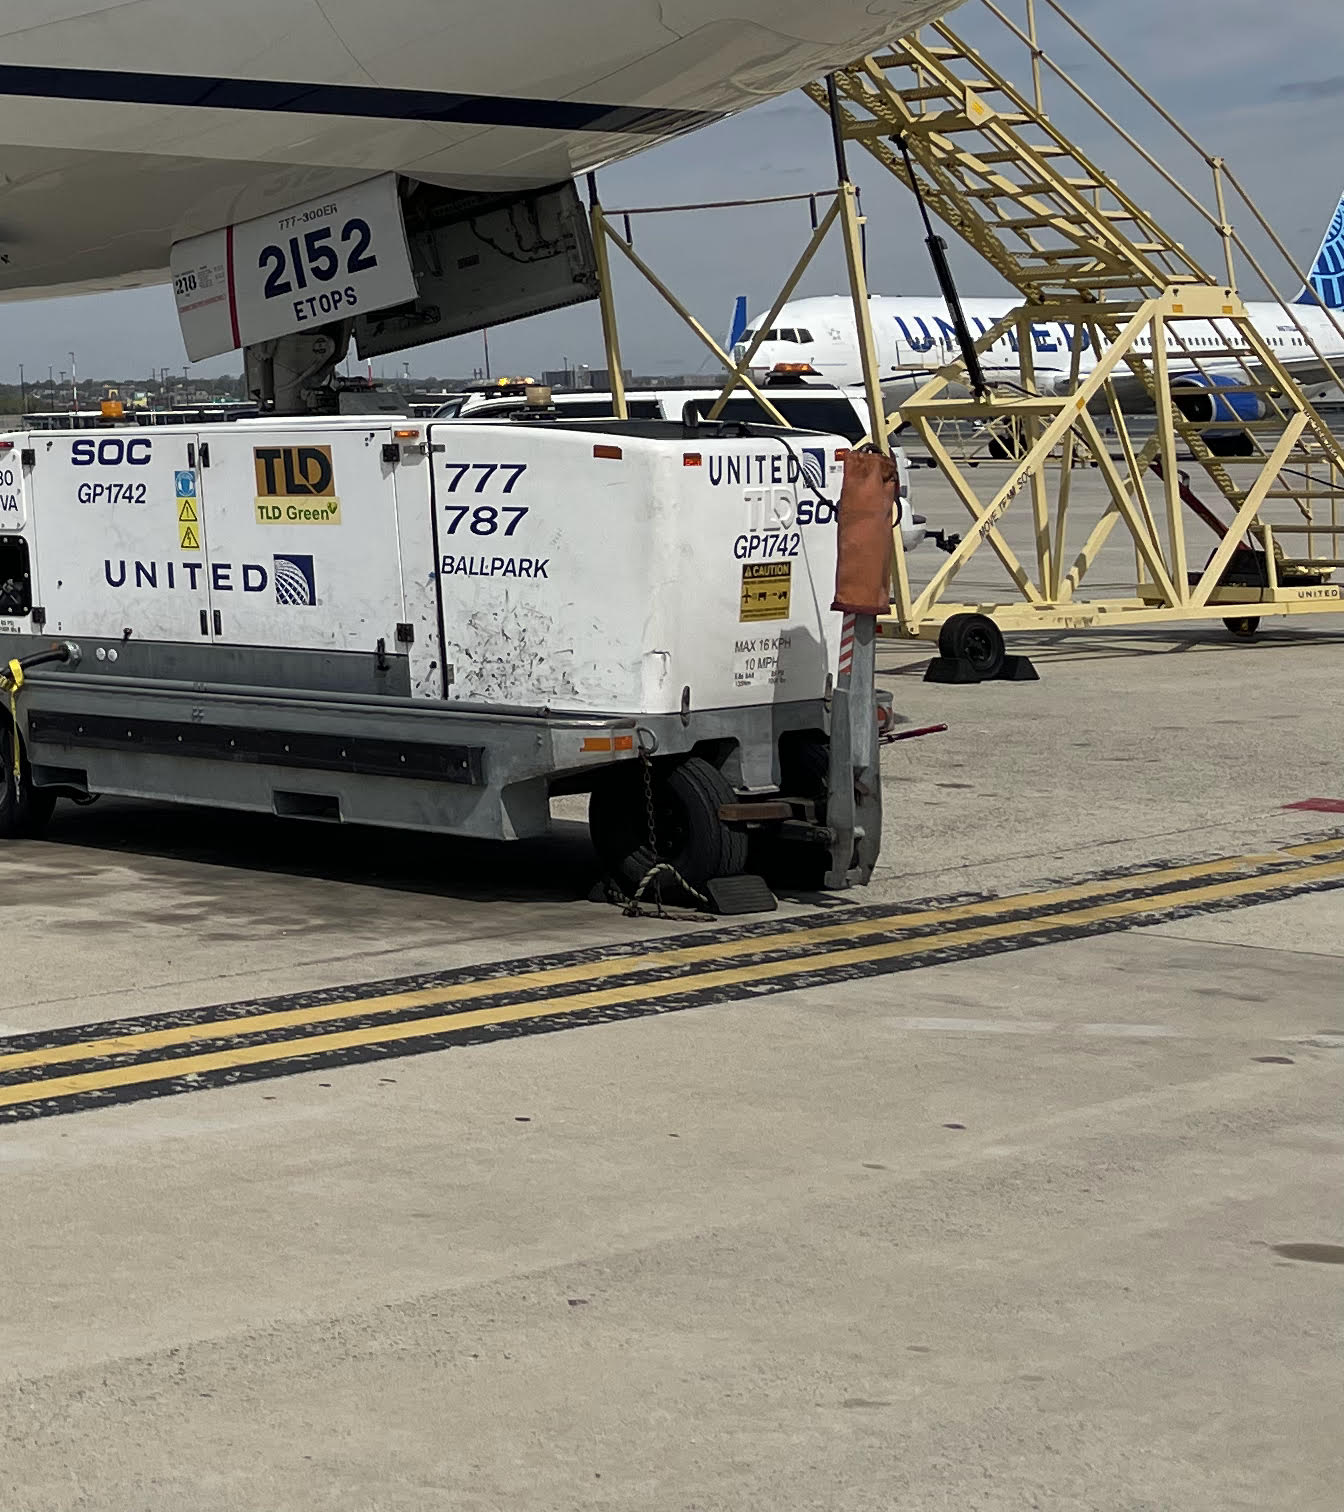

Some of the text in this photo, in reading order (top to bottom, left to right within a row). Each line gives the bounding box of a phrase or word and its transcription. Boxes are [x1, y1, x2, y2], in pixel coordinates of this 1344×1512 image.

[258, 217, 378, 300] 2152
[293, 286, 358, 322] ETOPS
[71, 438, 152, 466] SOC
[255, 447, 333, 495] TLD
[445, 463, 528, 494] 777
[709, 454, 801, 486] UNITED
[77, 482, 147, 504] GP1742
[257, 505, 330, 521] TLD Green
[444, 505, 530, 537] 787
[796, 499, 839, 526] SO
[733, 533, 801, 560] GP1742
[104, 559, 269, 592] UNITED
[441, 555, 551, 579] BALLPARK
[752, 564, 790, 577] CAUTION
[1297, 589, 1338, 599] UNITED
[735, 637, 792, 653] MAX 16 KPH
[744, 655, 779, 671] 10 MPH
